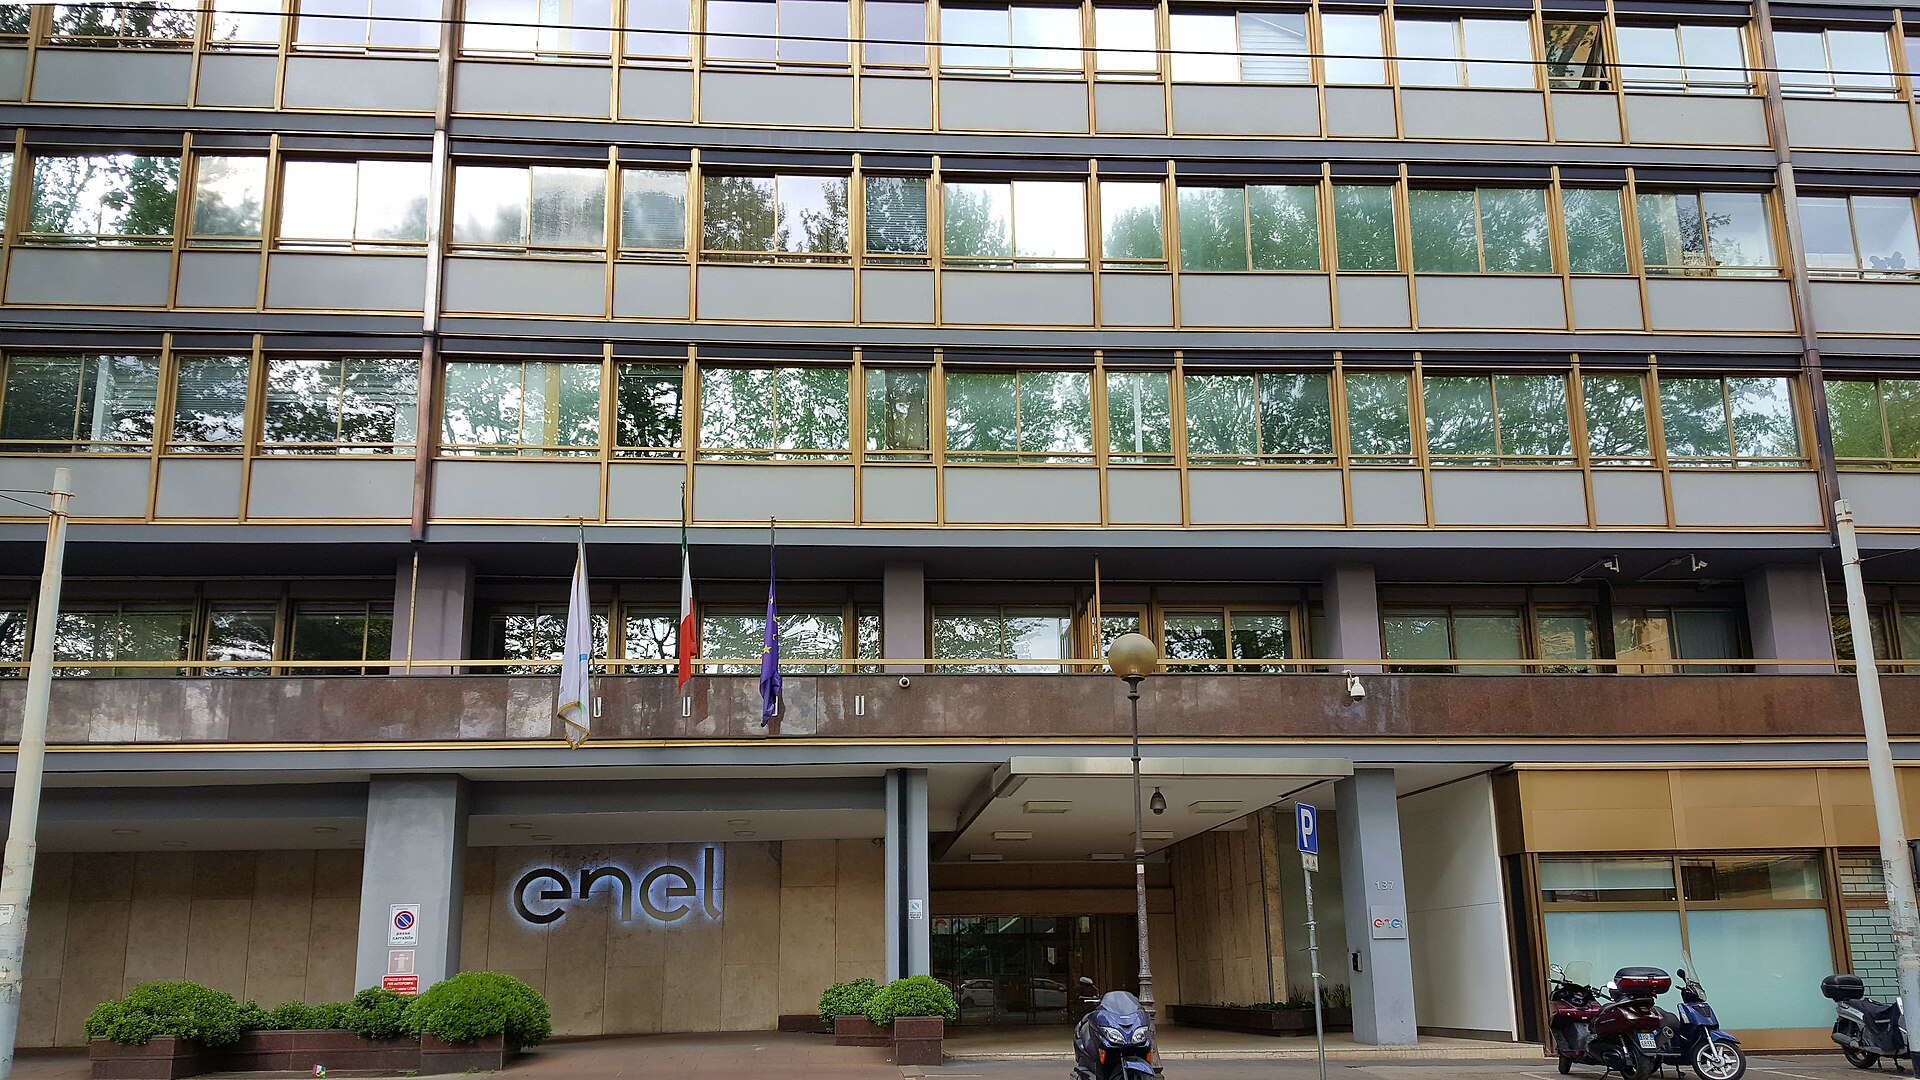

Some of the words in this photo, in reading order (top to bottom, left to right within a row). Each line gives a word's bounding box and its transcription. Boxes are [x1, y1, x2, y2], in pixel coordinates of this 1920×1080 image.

[1301, 808, 1313, 848] P
[514, 847, 721, 925] enel
[1375, 880, 1395, 891] 137
